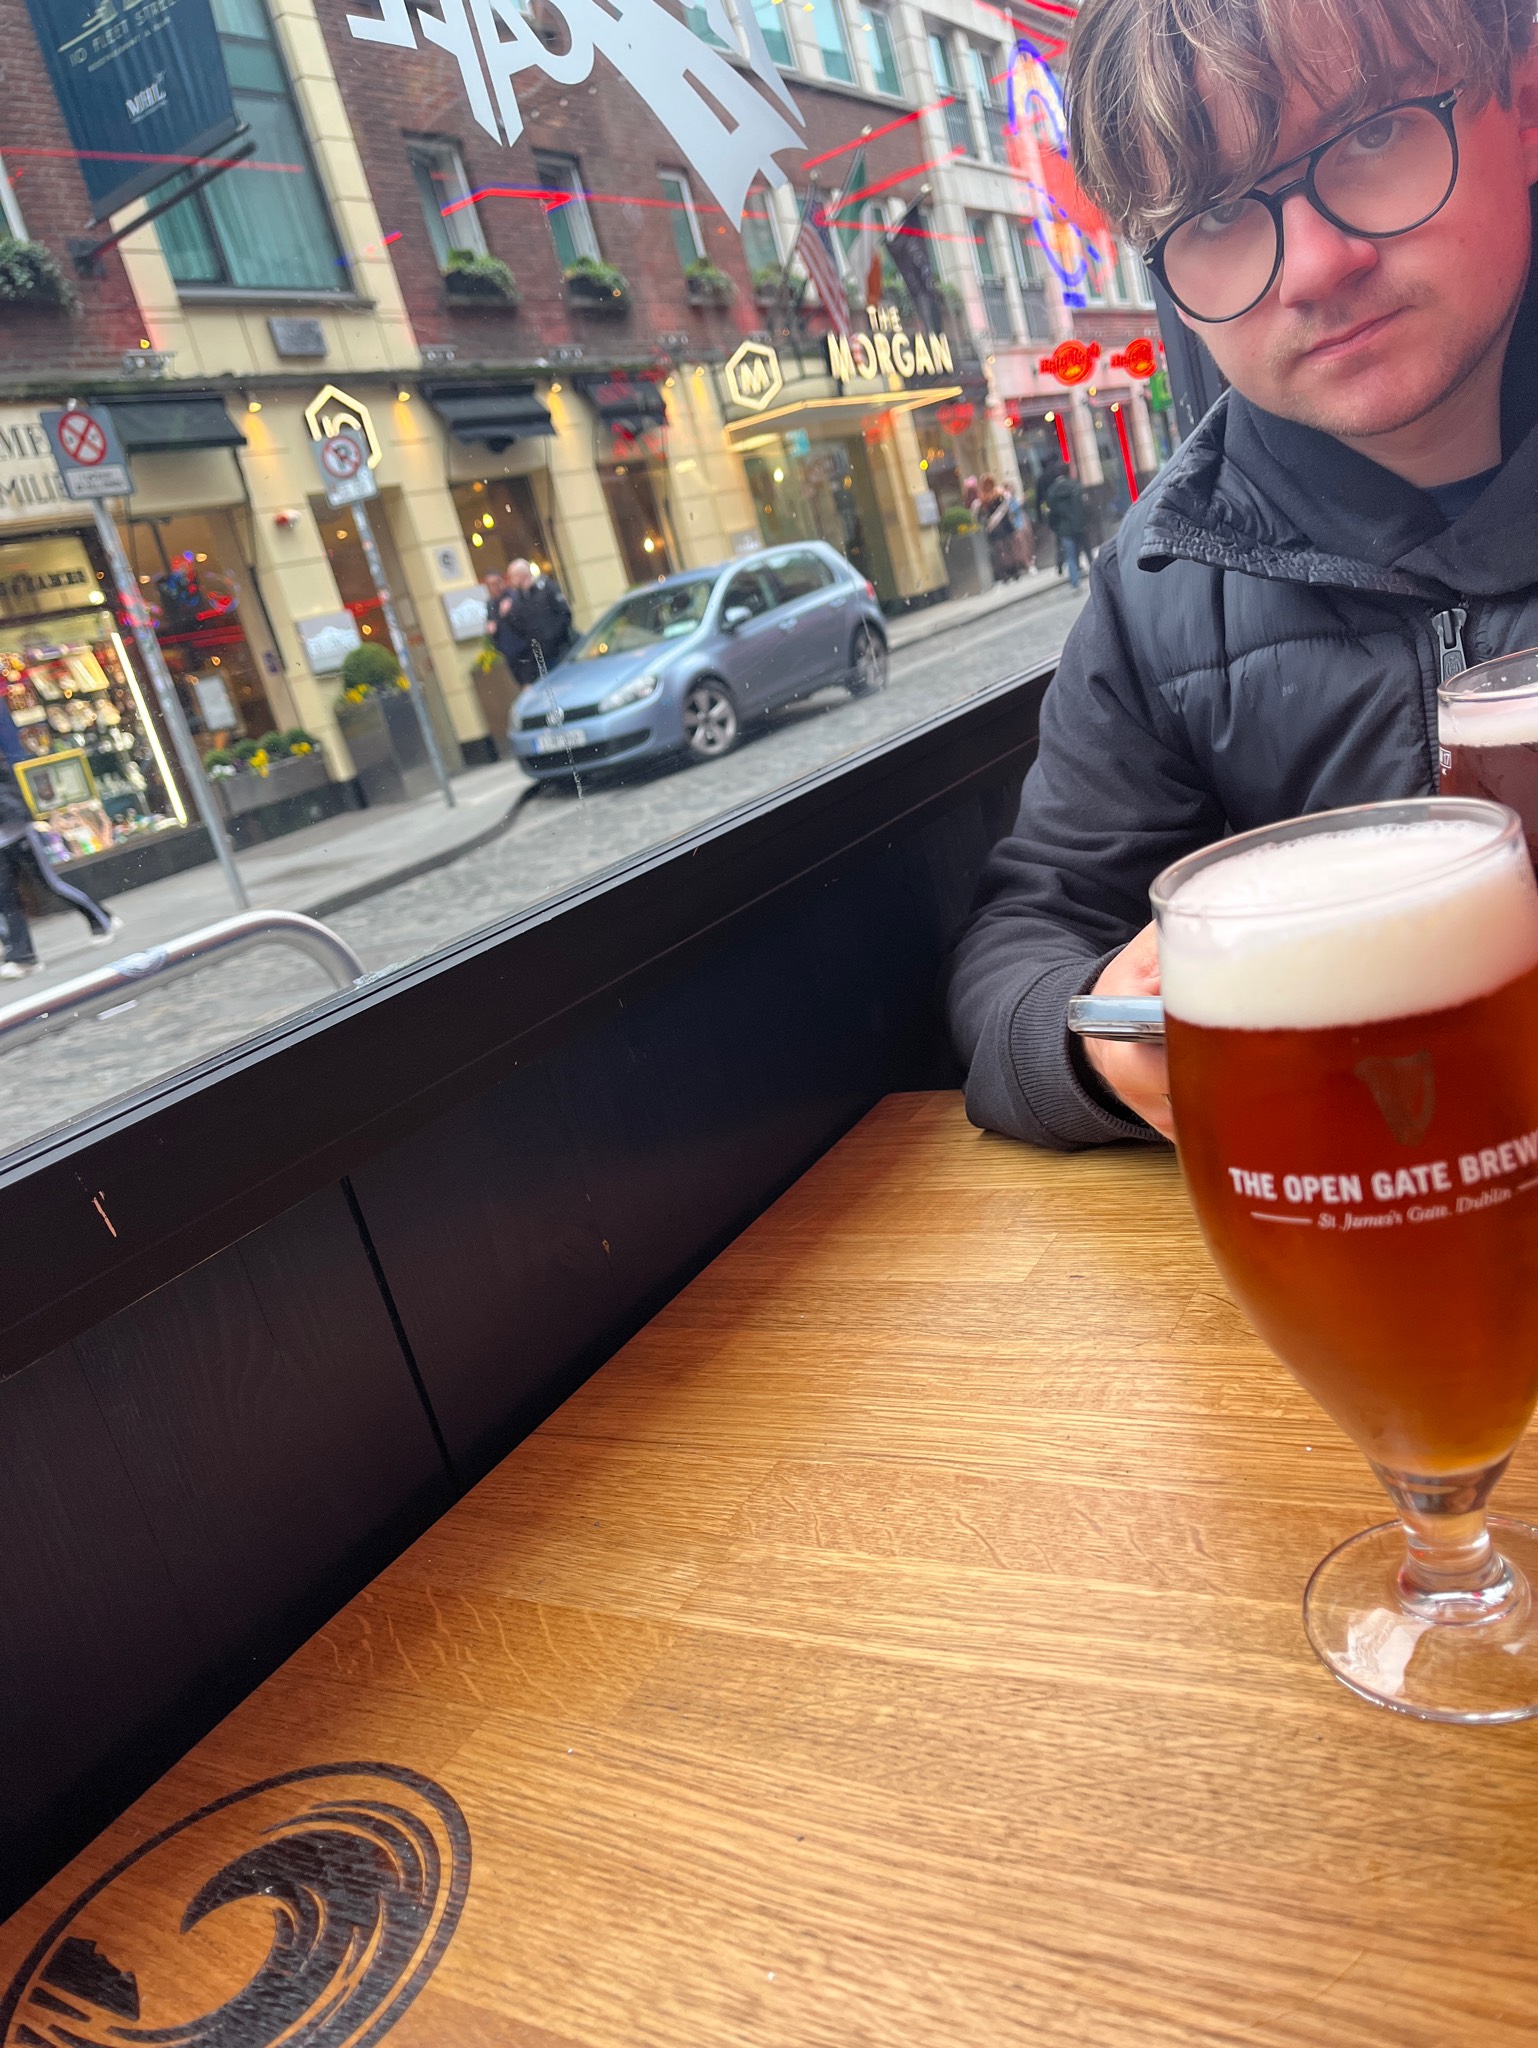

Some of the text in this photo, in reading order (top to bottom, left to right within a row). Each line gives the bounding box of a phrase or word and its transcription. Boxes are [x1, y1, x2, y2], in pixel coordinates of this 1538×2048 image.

[91, 19, 129, 52] FLEET
[866, 304, 903, 333] THE
[827, 330, 954, 385] MORGAN
[740, 357, 771, 395] M
[1228, 1166, 1278, 1201] THE
[1283, 1174, 1363, 1203] OPEN
[1370, 1161, 1451, 1200] GATE
[1455, 1187, 1512, 1213] Dublin
